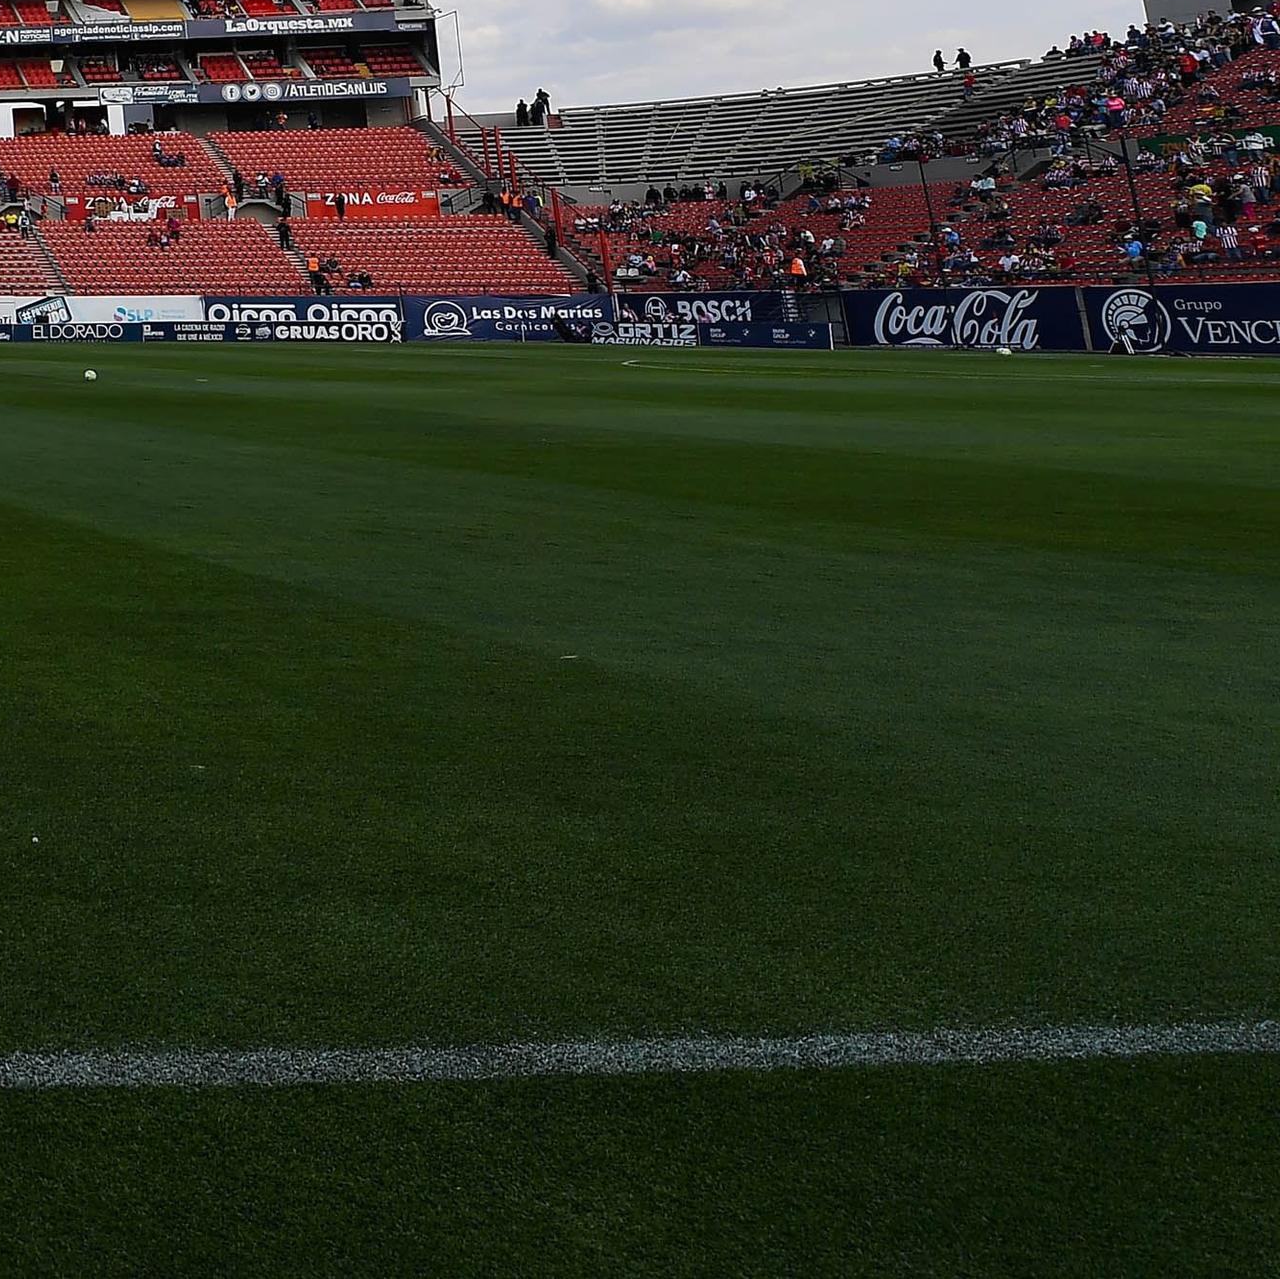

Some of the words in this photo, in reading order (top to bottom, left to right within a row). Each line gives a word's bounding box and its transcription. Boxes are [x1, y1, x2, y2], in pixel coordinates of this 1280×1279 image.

[225, 17, 353, 34] LaOrquesta.MX
[284, 82, 387, 97] /ATLETIDESANLUIS
[472, 306, 501, 319] Las
[504, 306, 537, 319] Dos
[540, 305, 603, 319] Marías
[677, 300, 752, 322] BOSCH
[1174, 299, 1222, 313] Grupo
[127, 309, 153, 321] SLP
[50, 324, 123, 338] DORADO
[275, 325, 339, 339] GRUAS
[341, 324, 388, 340] ORO
[618, 323, 697, 338] ORTIZ
[591, 337, 697, 347] MAQUINADOS
